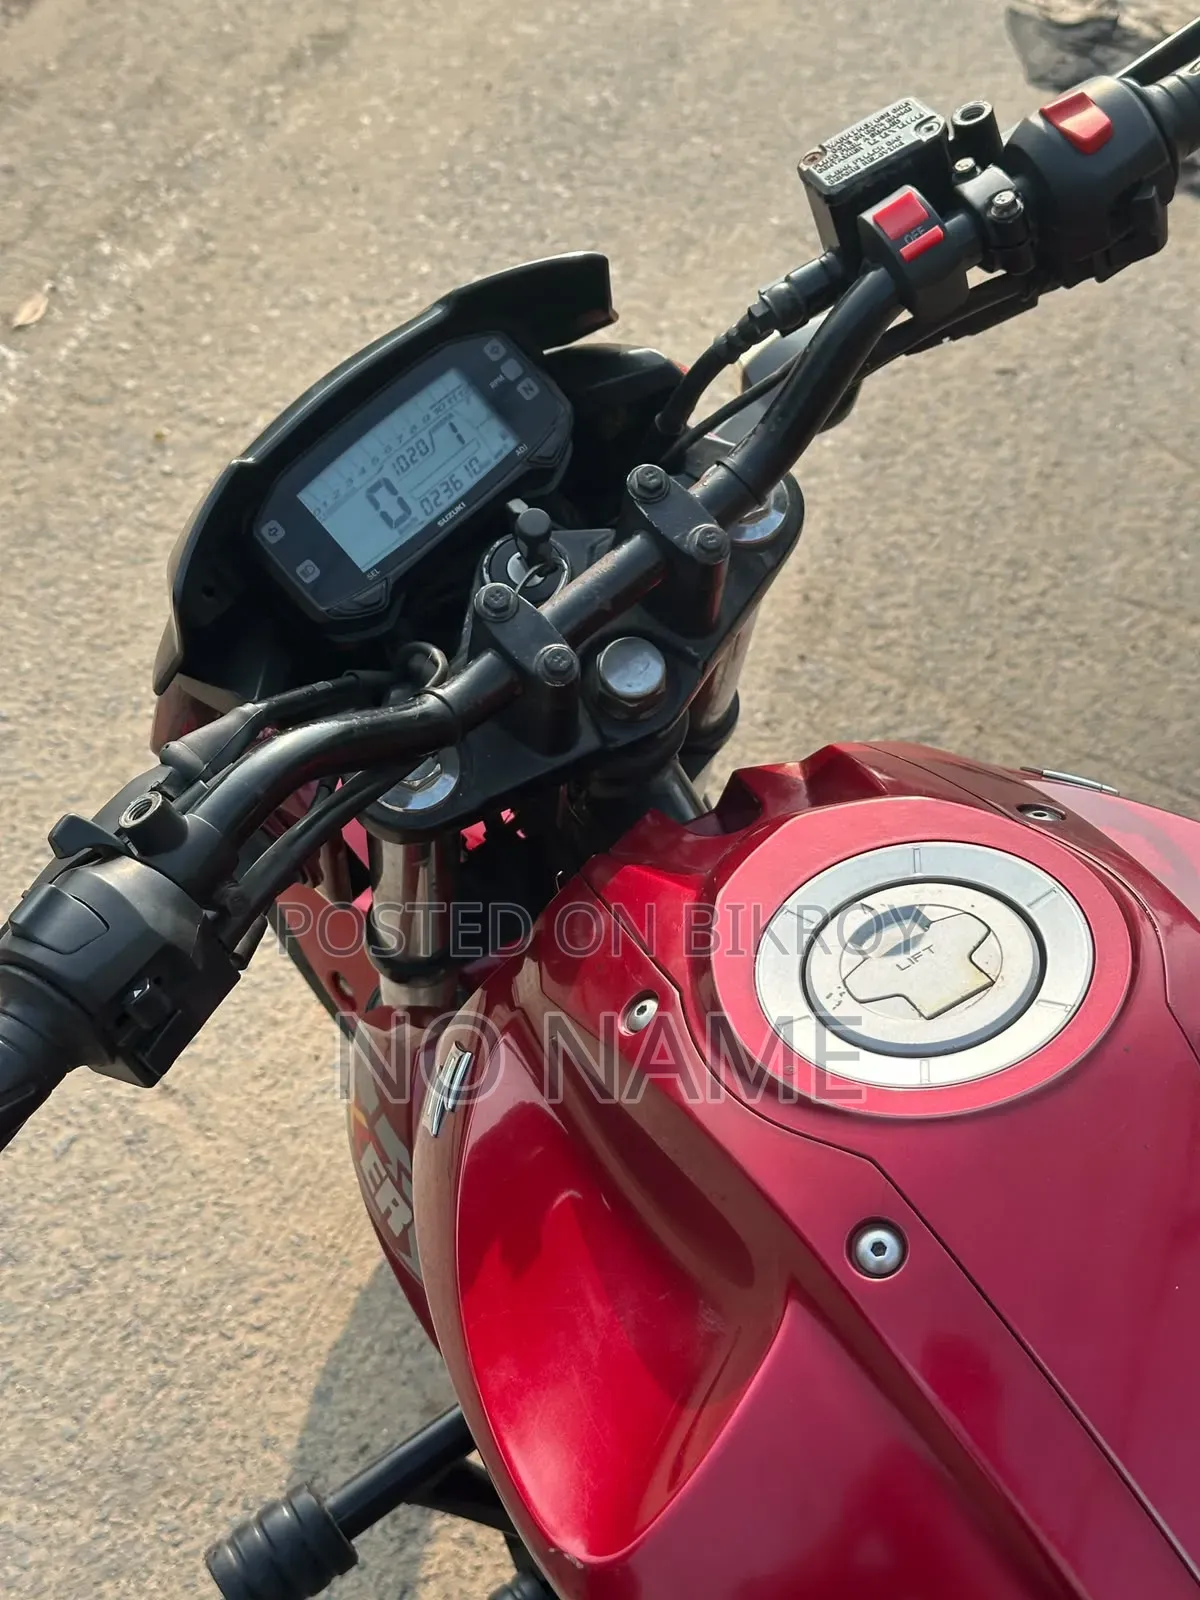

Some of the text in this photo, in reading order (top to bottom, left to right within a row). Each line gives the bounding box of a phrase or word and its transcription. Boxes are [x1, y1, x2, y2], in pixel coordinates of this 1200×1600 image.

[904, 225, 925, 243] OFF
[515, 443, 529, 457] ADJ
[365, 477, 412, 530] 0
[437, 502, 467, 528] SUZUKI
[366, 568, 381, 581] SEL
[895, 944, 935, 971] LIFT
